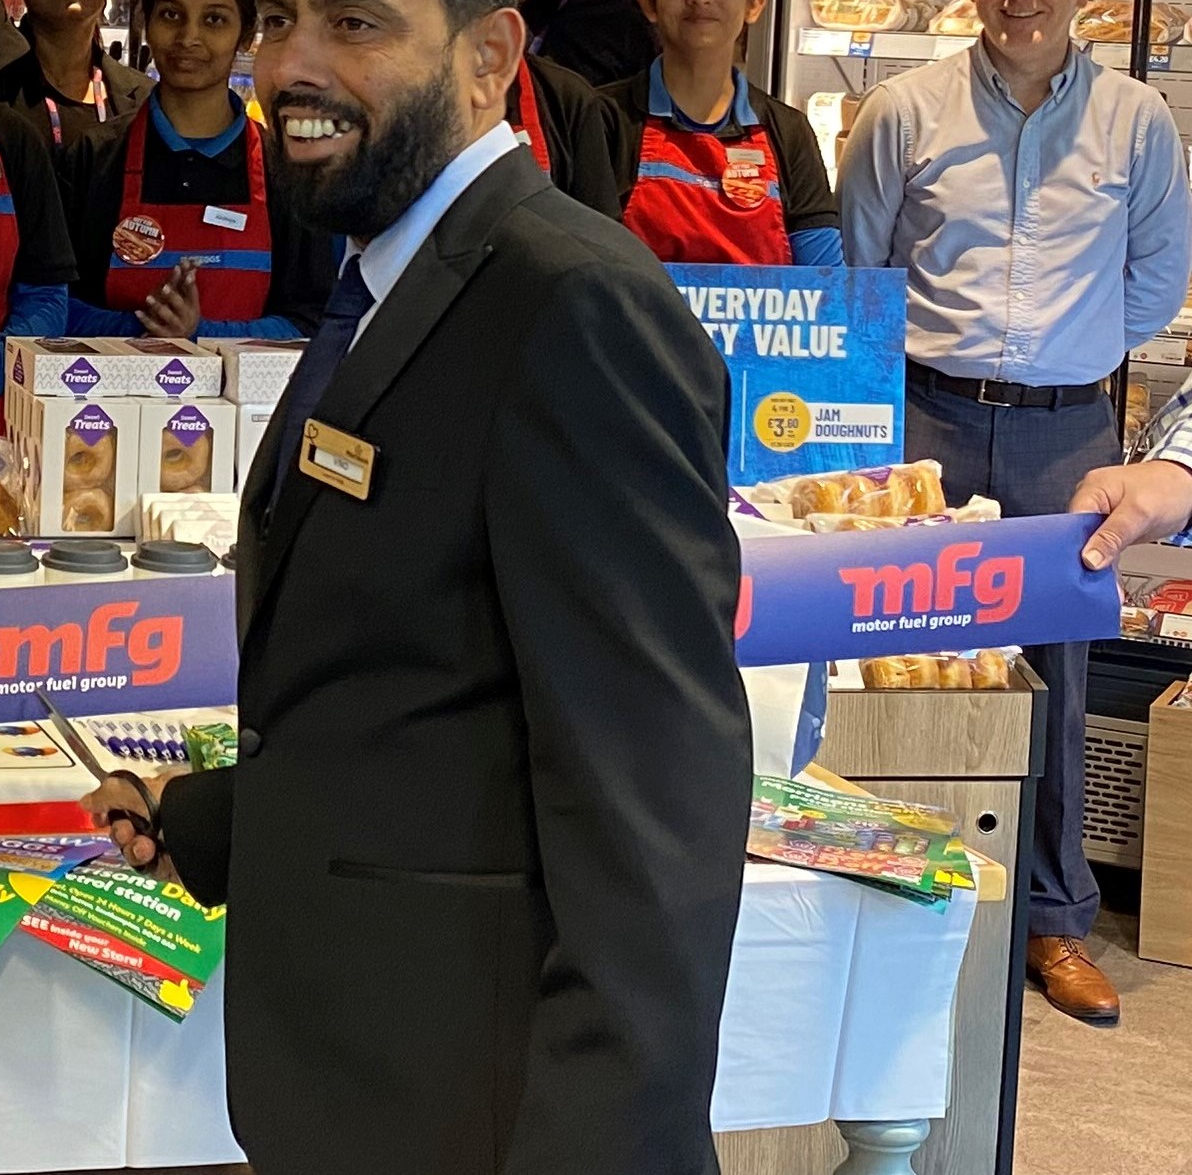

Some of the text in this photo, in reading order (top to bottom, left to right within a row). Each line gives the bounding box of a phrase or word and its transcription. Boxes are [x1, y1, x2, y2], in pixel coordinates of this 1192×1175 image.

[752, 324, 848, 359] VALUE
[65, 373, 98, 383] Treats
[159, 374, 191, 385] Treats
[815, 408, 841, 422] JAM
[74, 420, 110, 430] Treats
[171, 420, 206, 431] Treats
[815, 424, 888, 439] DOUGHNUTS
[838, 541, 1024, 625] mfg
[852, 614, 972, 633] motor fuel group
[46, 676, 77, 692] fuel
[80, 675, 128, 692] group
[65, 872, 182, 922] etrol station
[20, 915, 50, 931] SEE
[50, 923, 83, 940] inside
[144, 918, 166, 935] Days
[175, 934, 202, 954] Week
[68, 938, 143, 969] New Store!
